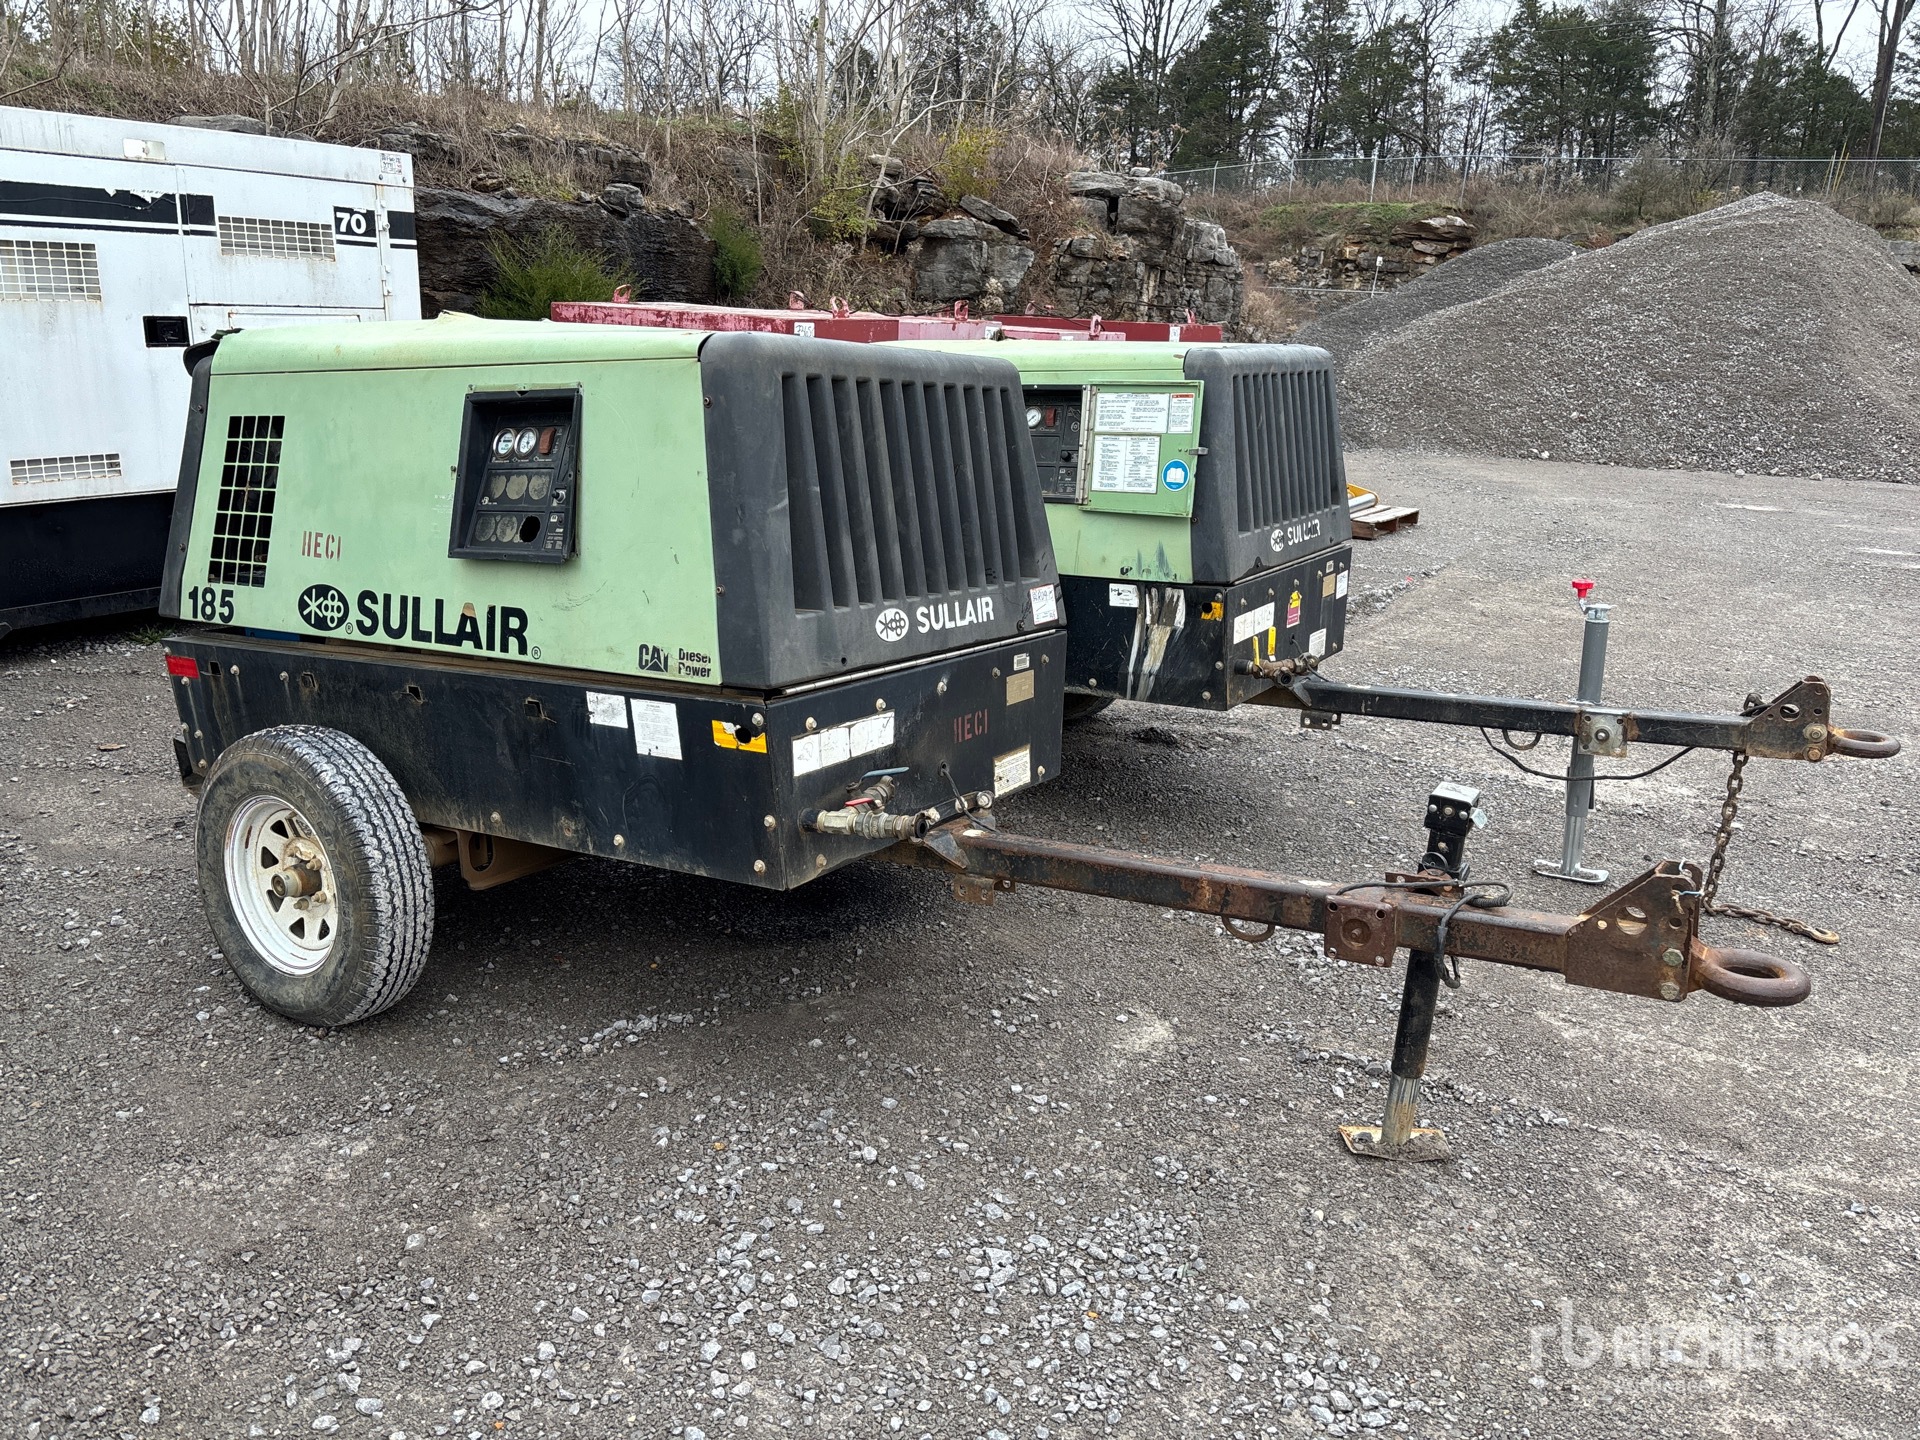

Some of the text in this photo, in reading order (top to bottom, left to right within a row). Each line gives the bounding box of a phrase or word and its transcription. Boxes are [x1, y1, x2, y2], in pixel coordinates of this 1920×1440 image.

[336, 212, 367, 235] 70
[1287, 519, 1321, 546] SULLAIR
[188, 585, 235, 624] 185
[915, 596, 995, 634] SULLAIR
[355, 590, 529, 656] SULLAIR
[678, 661, 712, 678] Power
